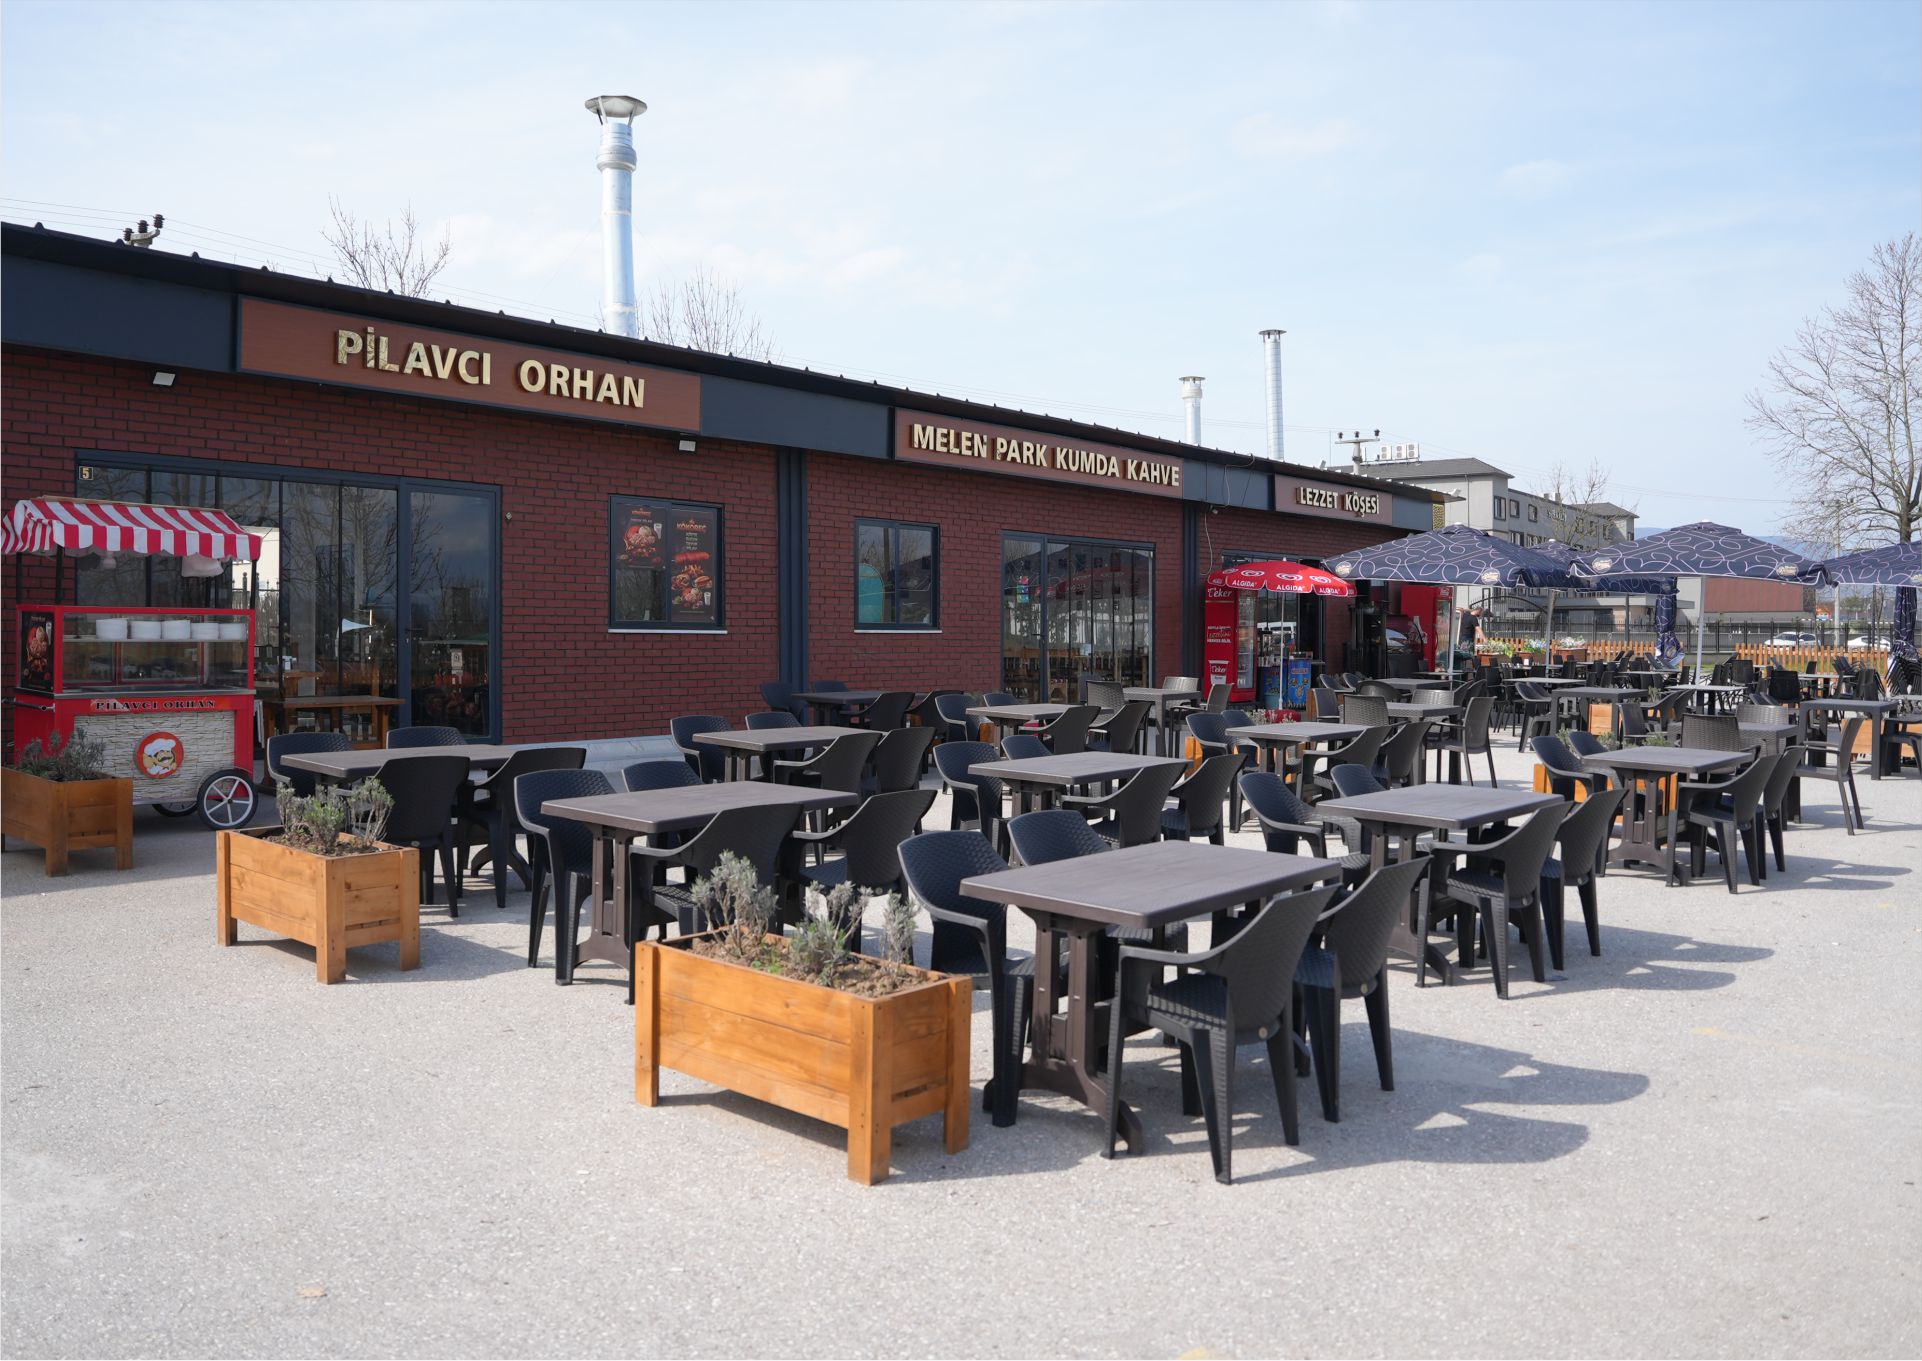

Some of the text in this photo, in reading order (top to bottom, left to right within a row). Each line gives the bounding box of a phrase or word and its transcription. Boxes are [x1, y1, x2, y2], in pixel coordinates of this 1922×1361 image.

[337, 327, 645, 408] PİLAVCI ORHAN
[913, 423, 1180, 487] MELEN PARK KUMDA KAHVE
[82, 467, 90, 479] 5
[1300, 487, 1380, 517] LEZZET KÖŞESİ
[1276, 584, 1303, 592] ALGIDA
[164, 700, 216, 709] ORHAN
